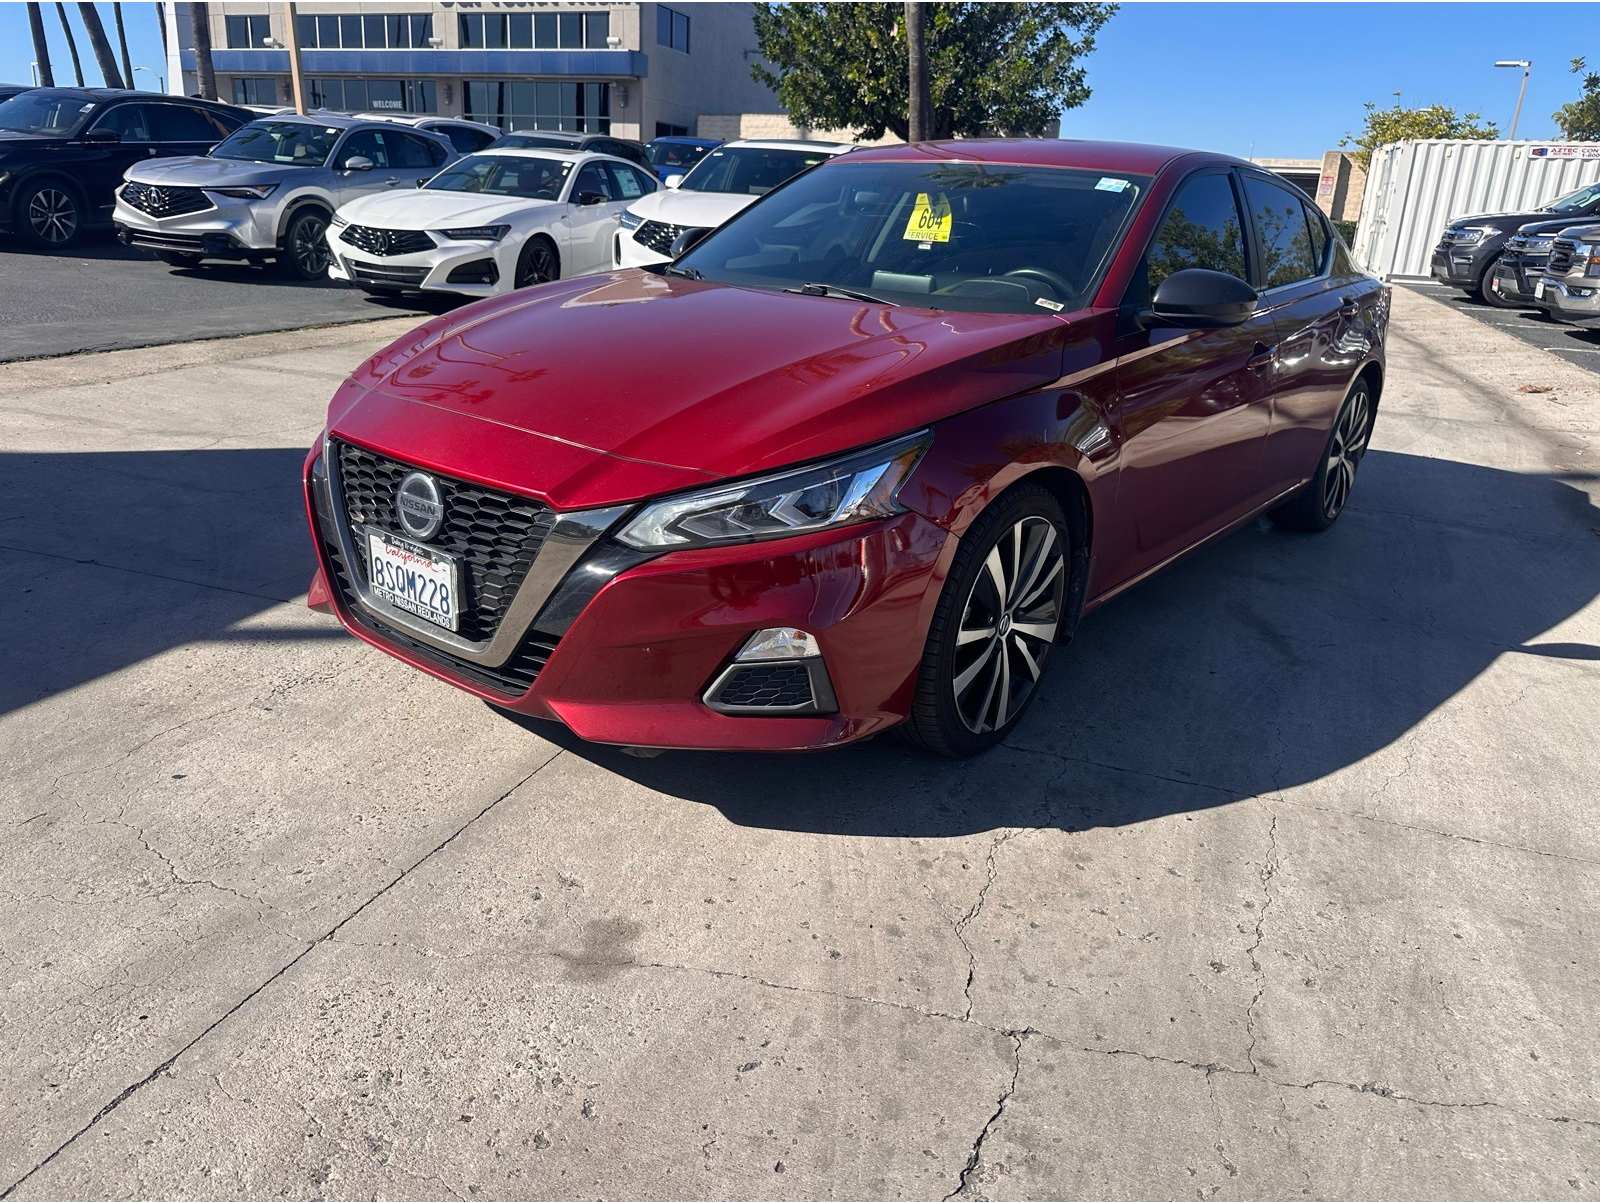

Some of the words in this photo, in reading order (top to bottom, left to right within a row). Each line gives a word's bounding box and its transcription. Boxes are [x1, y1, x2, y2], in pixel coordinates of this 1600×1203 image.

[372, 100, 403, 109] WELCOME
[909, 231, 940, 241] ERVICE
[400, 496, 436, 516] NISSAN
[385, 543, 433, 569] California
[374, 556, 450, 616] 8SQM228
[395, 597, 418, 614] NISSAN
[417, 606, 451, 629] REDLANDS
